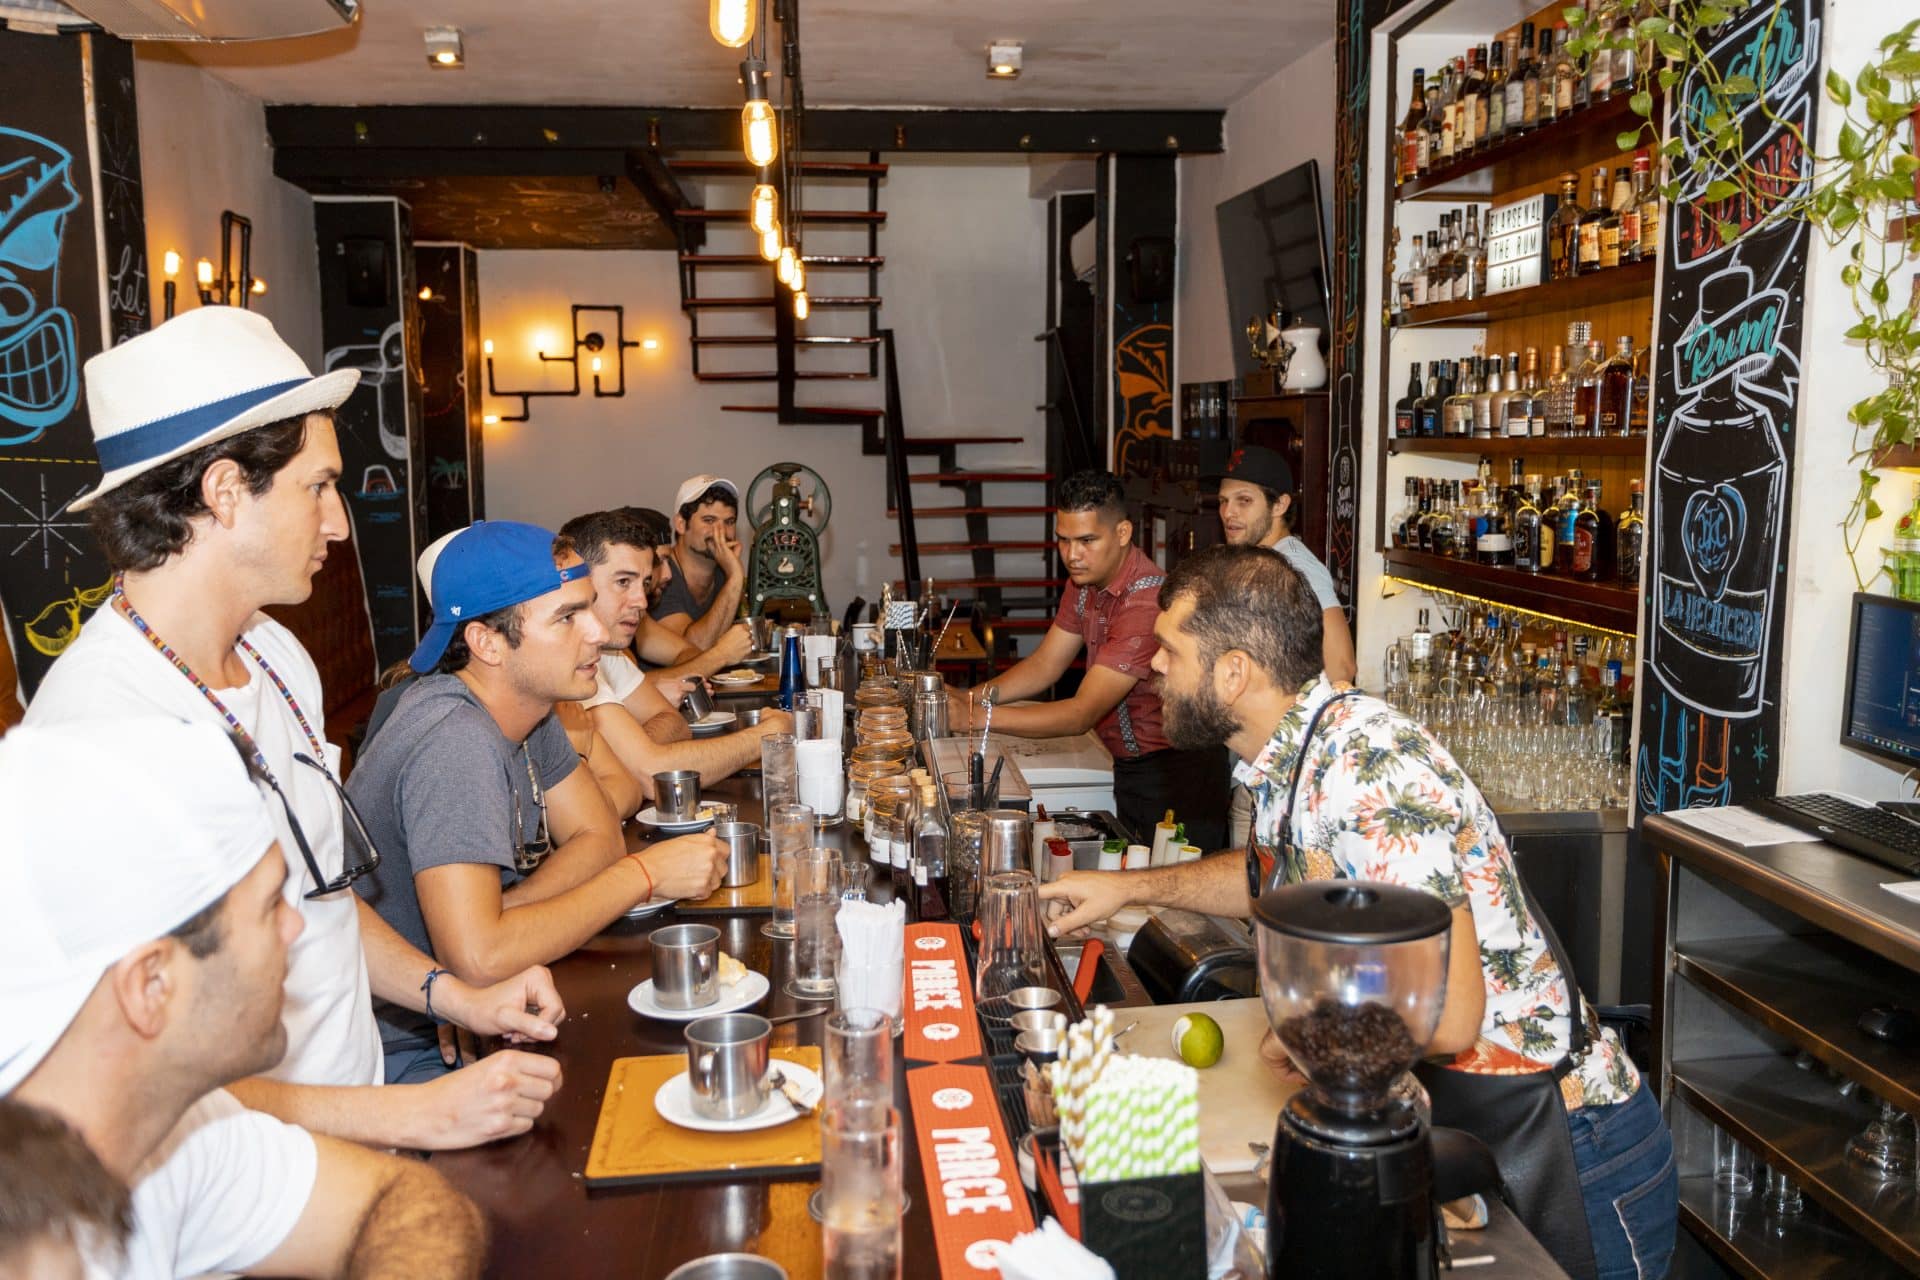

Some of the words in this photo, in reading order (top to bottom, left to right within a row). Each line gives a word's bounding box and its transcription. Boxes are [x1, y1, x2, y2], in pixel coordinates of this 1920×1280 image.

[1494, 239, 1510, 262] THE
[1516, 231, 1537, 256] RUM
[109, 245, 145, 315] Let
[1501, 264, 1521, 288] BOX
[1684, 306, 1777, 384] Rum
[1664, 584, 1684, 620] LA
[931, 1126, 1013, 1217] PARCE
